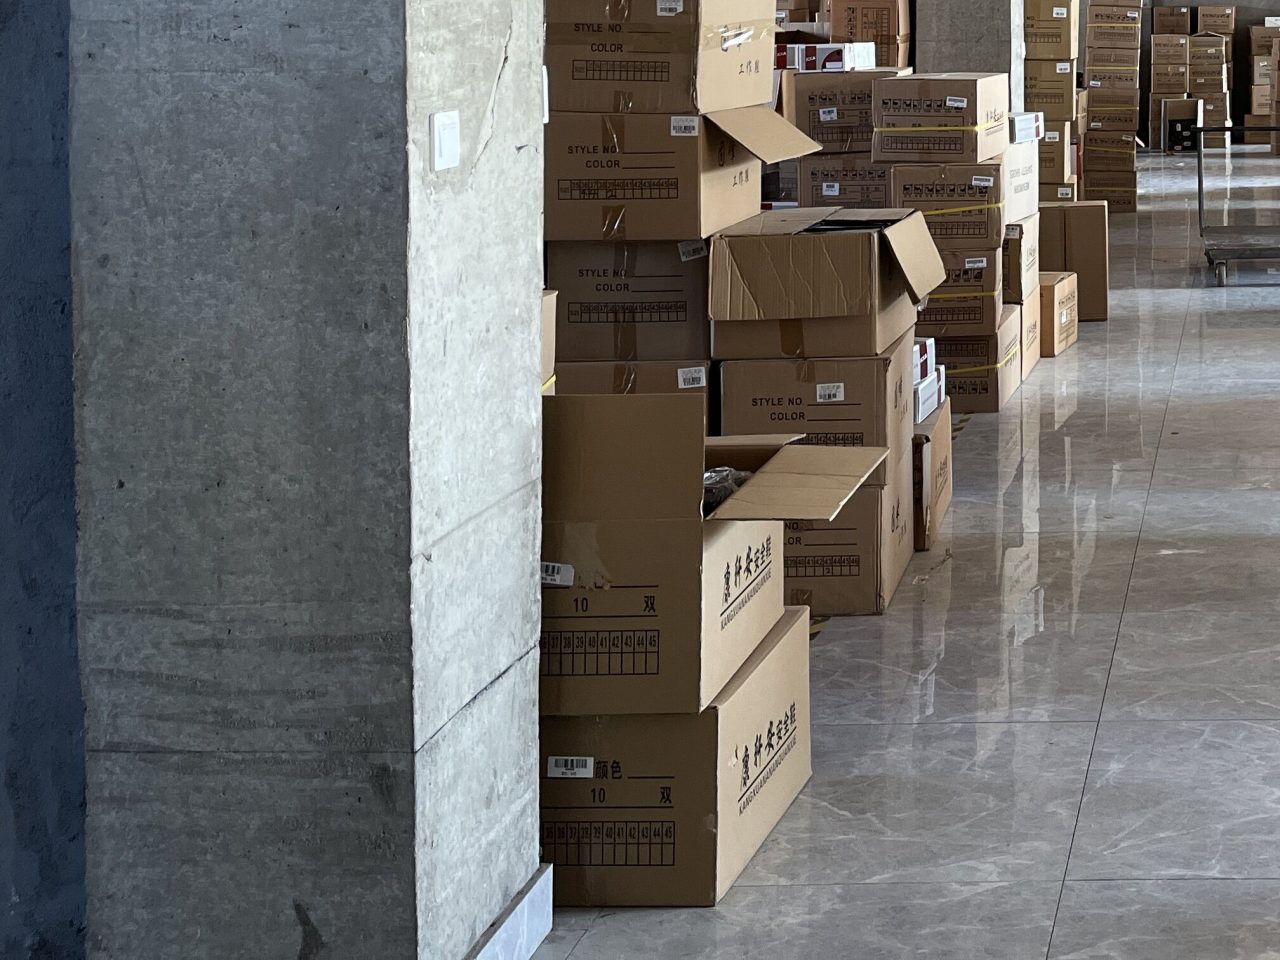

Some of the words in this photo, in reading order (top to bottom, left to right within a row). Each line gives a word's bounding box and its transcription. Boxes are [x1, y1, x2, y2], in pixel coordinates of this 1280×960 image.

[574, 22, 602, 32] STYLE
[590, 43, 624, 52] COLOR
[568, 146, 599, 154] STYLE
[586, 160, 620, 168] COLOR
[578, 268, 608, 278] STYLE
[595, 283, 630, 292] COLOR
[751, 398, 784, 406] STYLE
[770, 412, 806, 421] COLOR
[573, 597, 588, 612] 10
[643, 595, 656, 613] 双
[594, 760, 623, 780] 颜色
[590, 788, 606, 803] 10
[660, 786, 672, 804] 双
